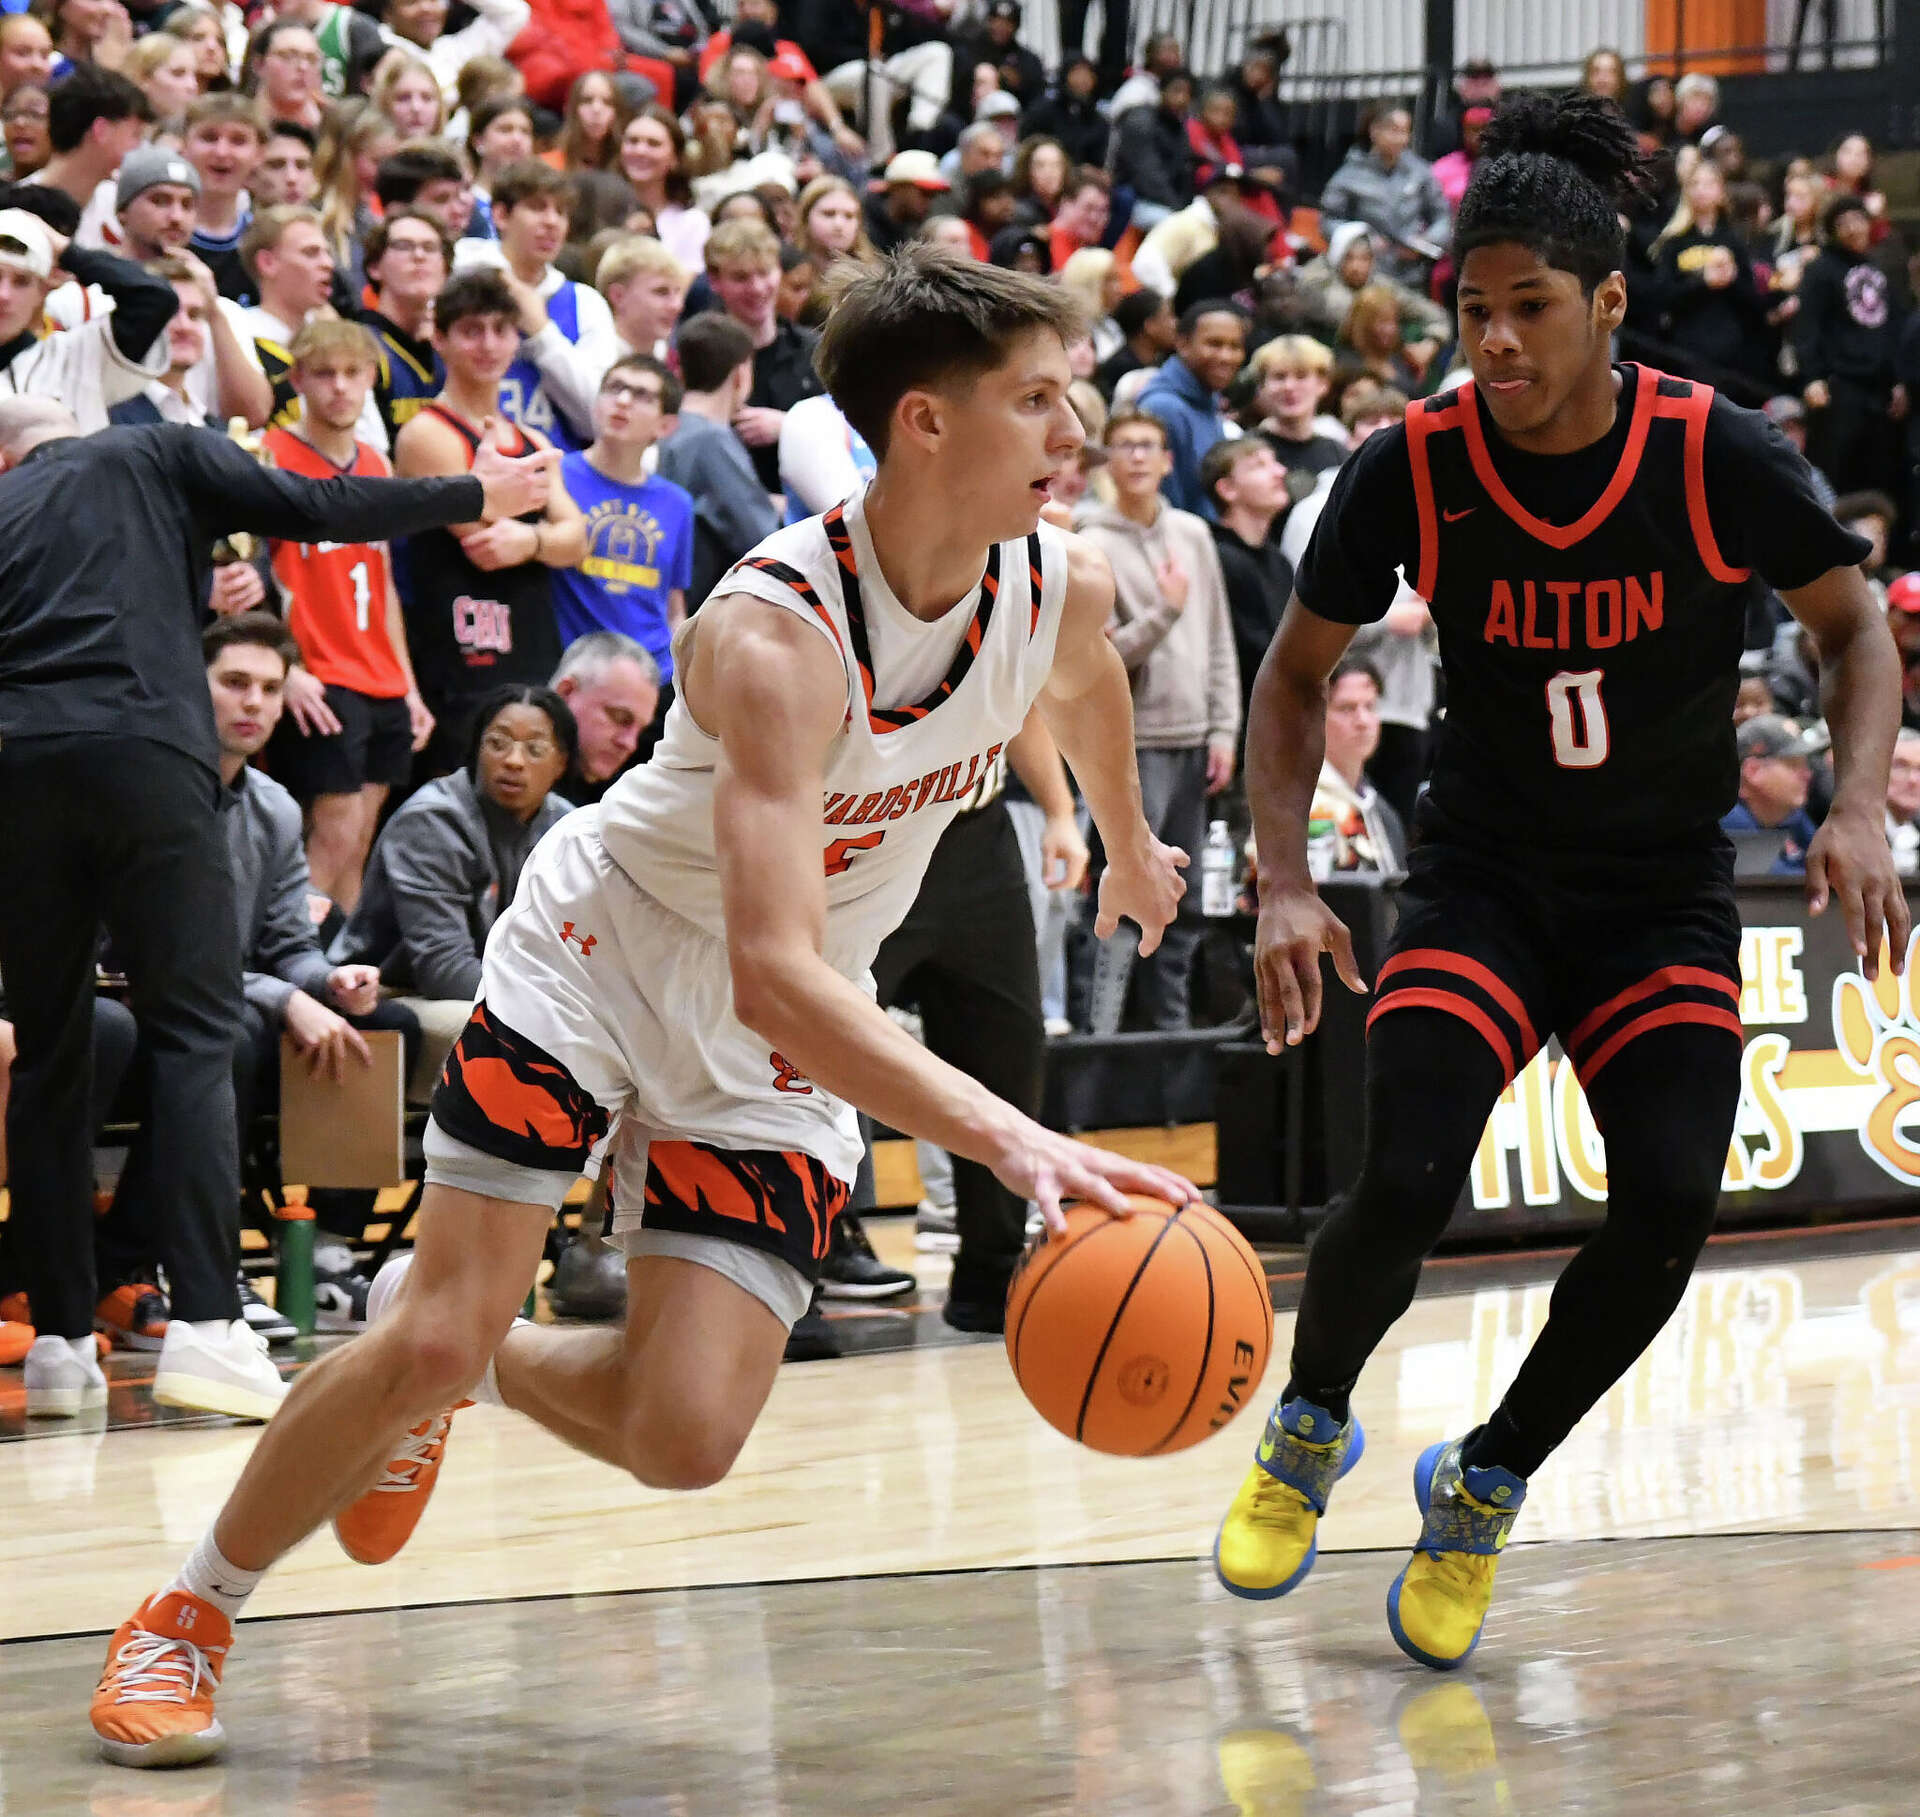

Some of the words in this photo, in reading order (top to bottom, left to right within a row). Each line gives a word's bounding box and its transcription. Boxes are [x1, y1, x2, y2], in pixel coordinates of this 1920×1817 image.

[350, 561, 371, 631] 1
[1484, 570, 1664, 649] ALTON
[1545, 668, 1610, 769] 0
